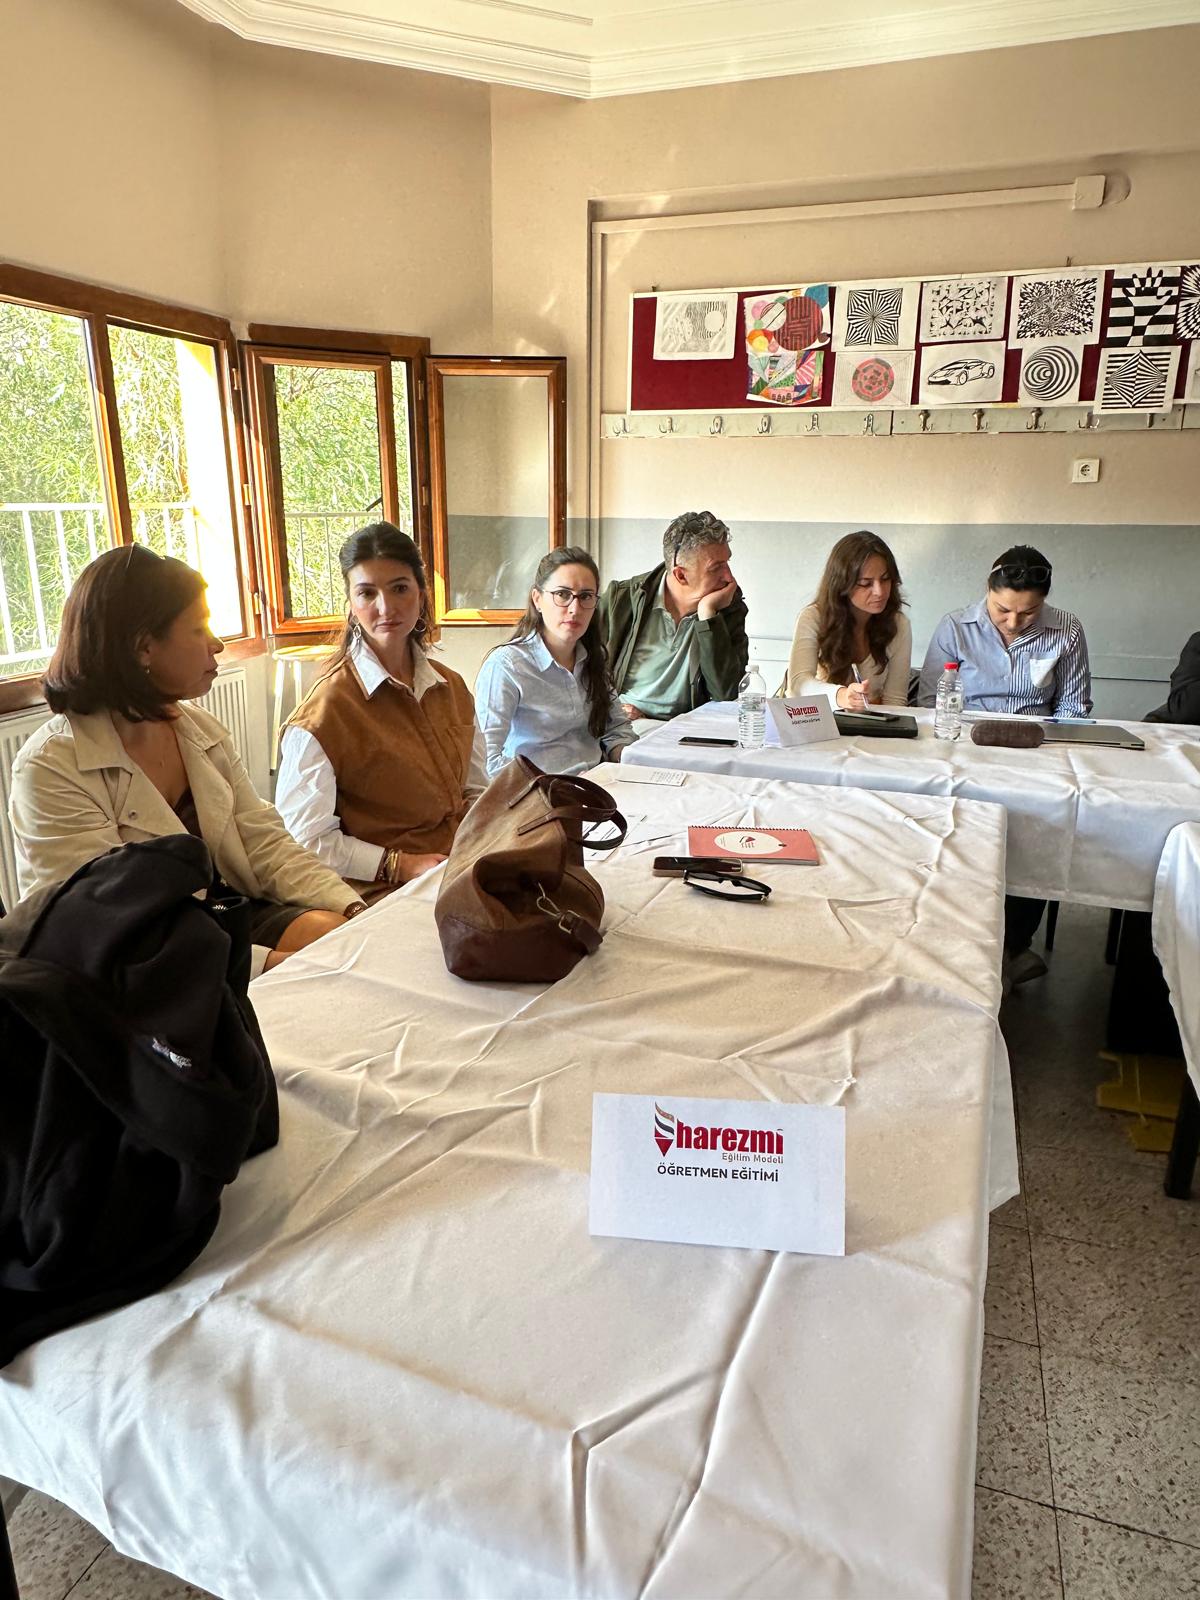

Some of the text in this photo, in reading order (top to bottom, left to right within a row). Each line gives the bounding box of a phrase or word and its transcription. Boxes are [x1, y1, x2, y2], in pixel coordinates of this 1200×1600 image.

[722, 1152, 784, 1164] Eğitim Modeli
[657, 1162, 779, 1182] ÖĞRETMEN EĞİTİMİ
